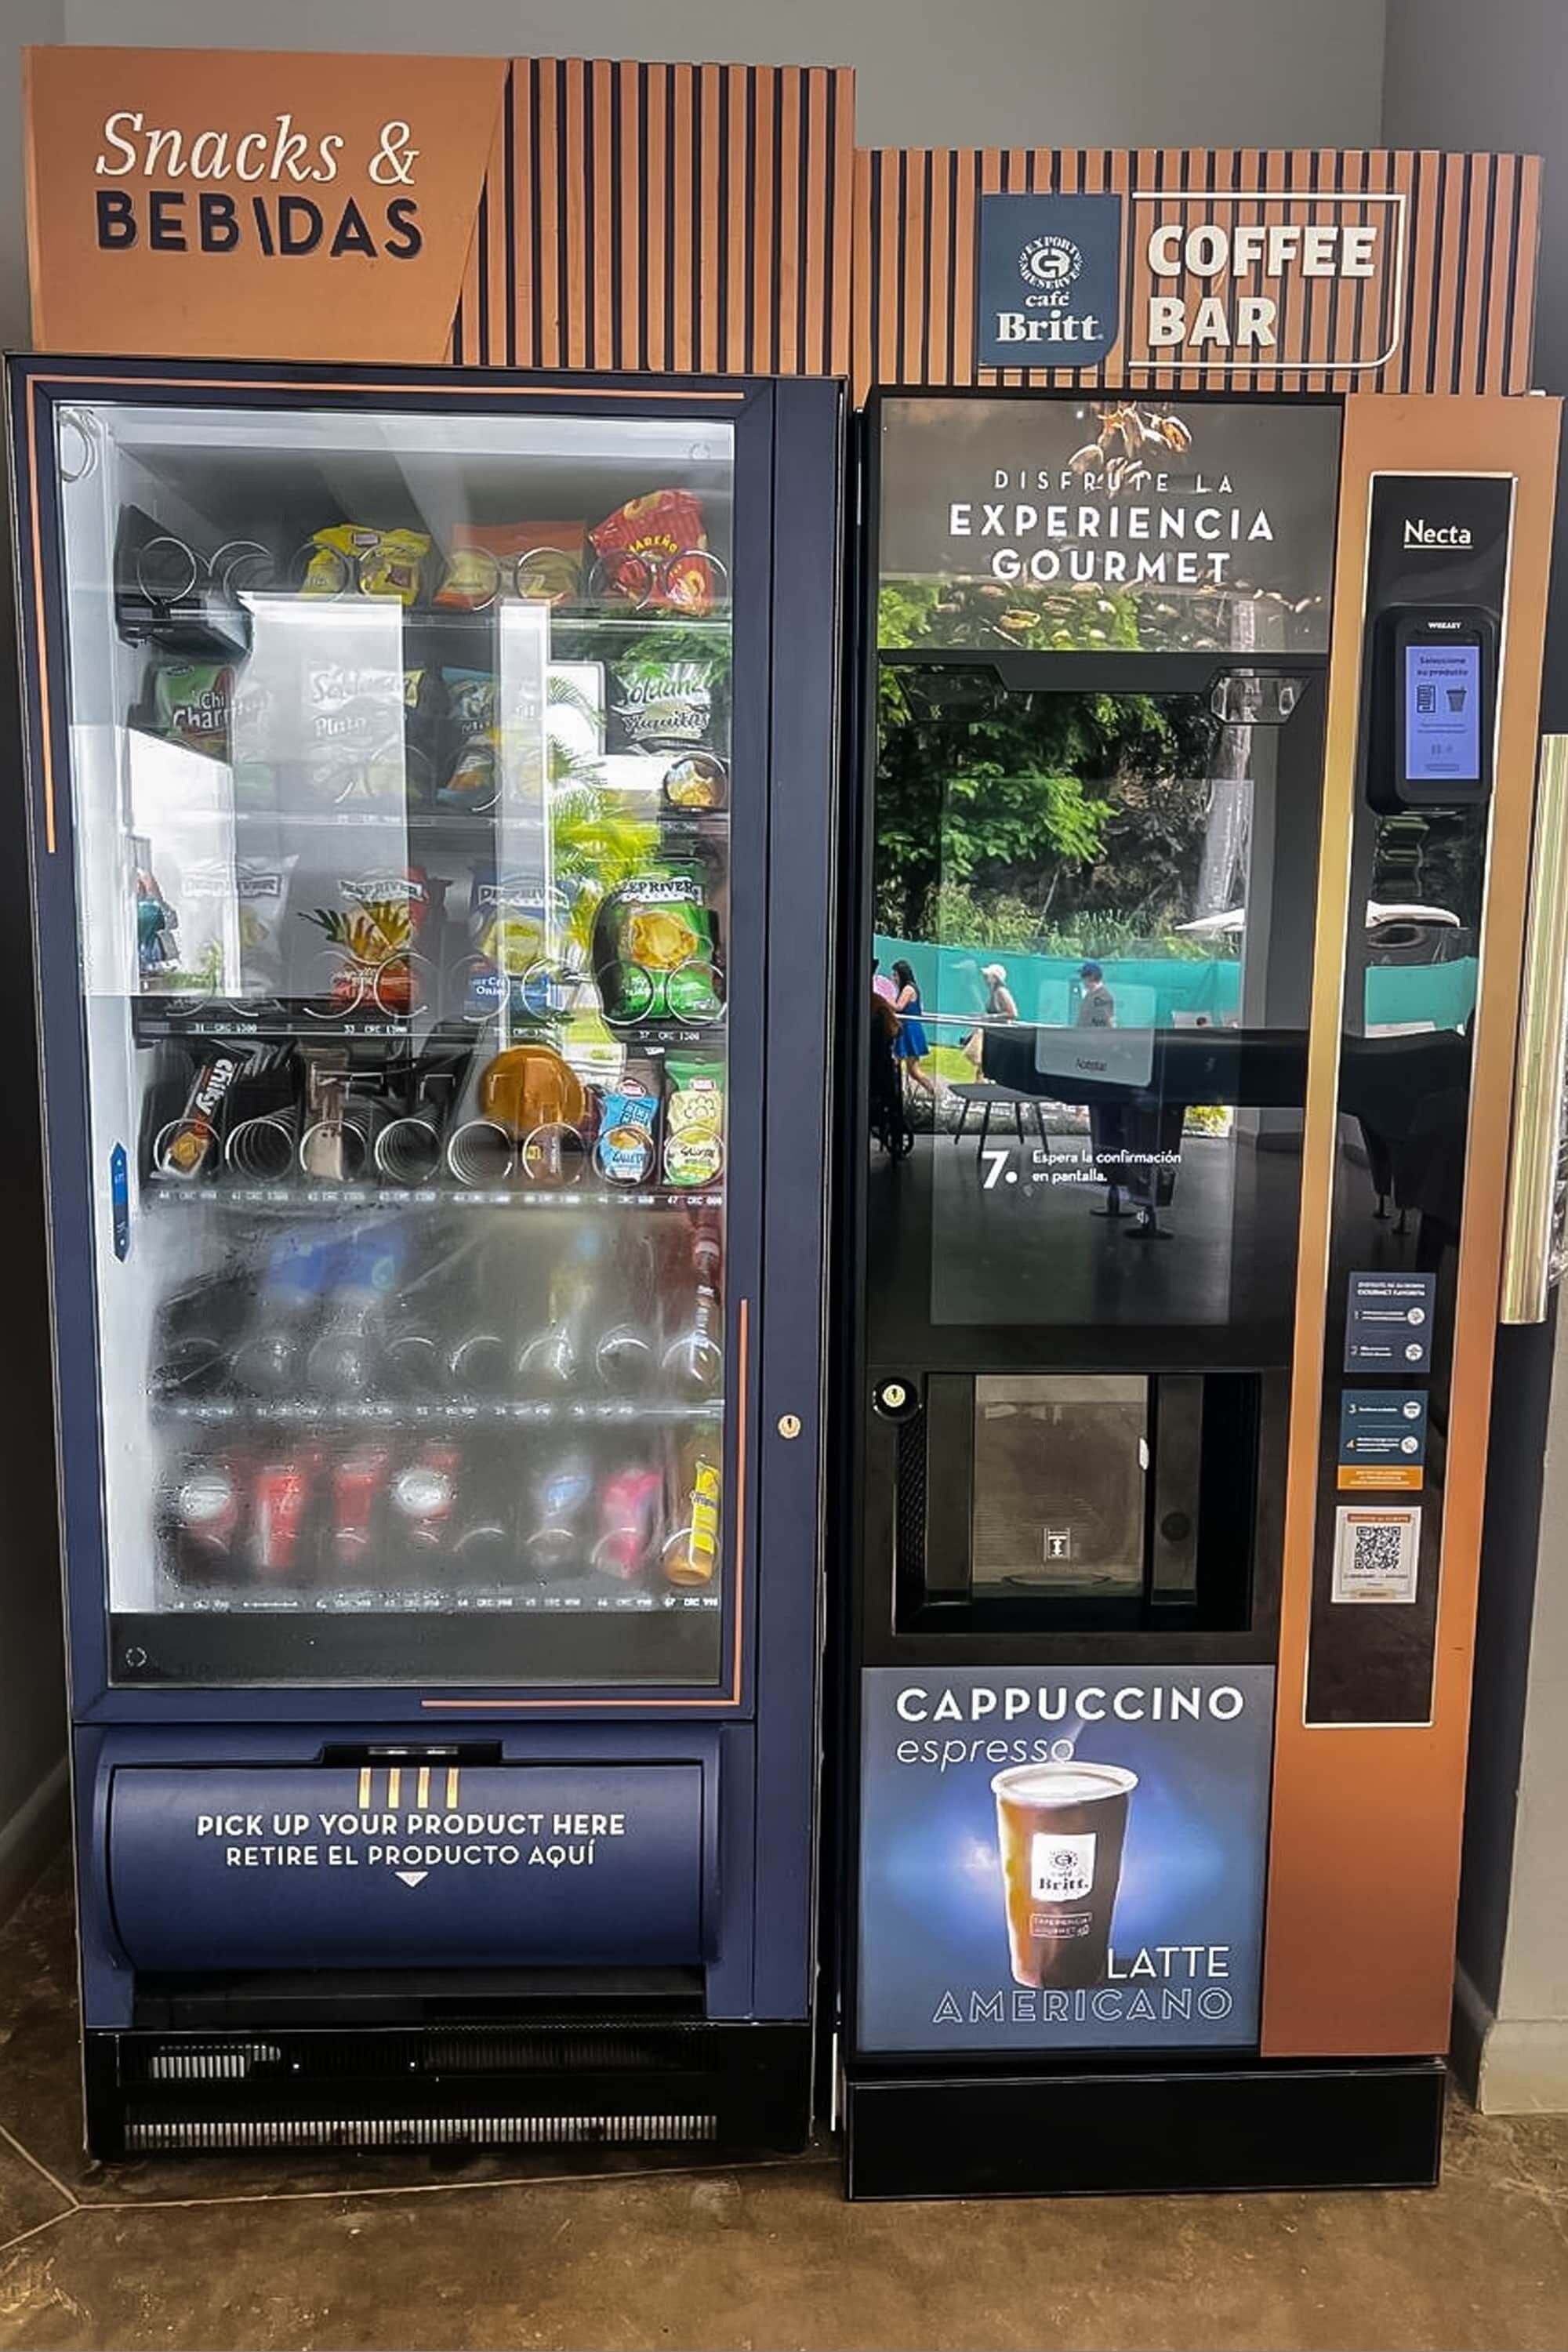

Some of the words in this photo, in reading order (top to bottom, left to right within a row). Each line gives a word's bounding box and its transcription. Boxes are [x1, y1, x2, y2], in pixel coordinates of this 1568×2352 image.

[95, 111, 344, 182] Snacks
[368, 121, 420, 185] &
[96, 190, 423, 259] BEBIDAS
[1149, 225, 1378, 278] COFFEE
[1025, 291, 1070, 307] café
[996, 310, 1099, 342] Britt
[1149, 296, 1278, 347] BAR
[993, 470, 1171, 494] DISFRUTE
[1196, 473, 1234, 495] LA
[949, 504, 1275, 542] EXPERIENCIA
[1403, 519, 1472, 544] Necta
[991, 550, 1232, 583] GOURMET
[982, 1150, 1018, 1189] 7.
[1032, 1150, 1078, 1167] Espera
[1081, 1149, 1093, 1163] la
[1096, 1149, 1182, 1164] confirmación
[1032, 1173, 1049, 1183] en
[1051, 1168, 1108, 1184] pantalla.
[896, 1686, 1244, 1722] CAPPUCCINO
[897, 1739, 1075, 1773] espresso
[198, 1814, 263, 1836] PICK
[273, 1814, 310, 1835] UP
[319, 1814, 398, 1835] YOUR
[407, 1813, 544, 1835] PRODUCT
[553, 1814, 626, 1835] HERE
[226, 1846, 318, 1866] RETIRE
[328, 1846, 358, 1865] EL
[368, 1845, 520, 1865] PRODUCTO
[528, 1839, 595, 1867] AQUÍ
[1107, 1947, 1230, 1979] LATTE
[932, 1987, 1233, 2024] AMERICANO
